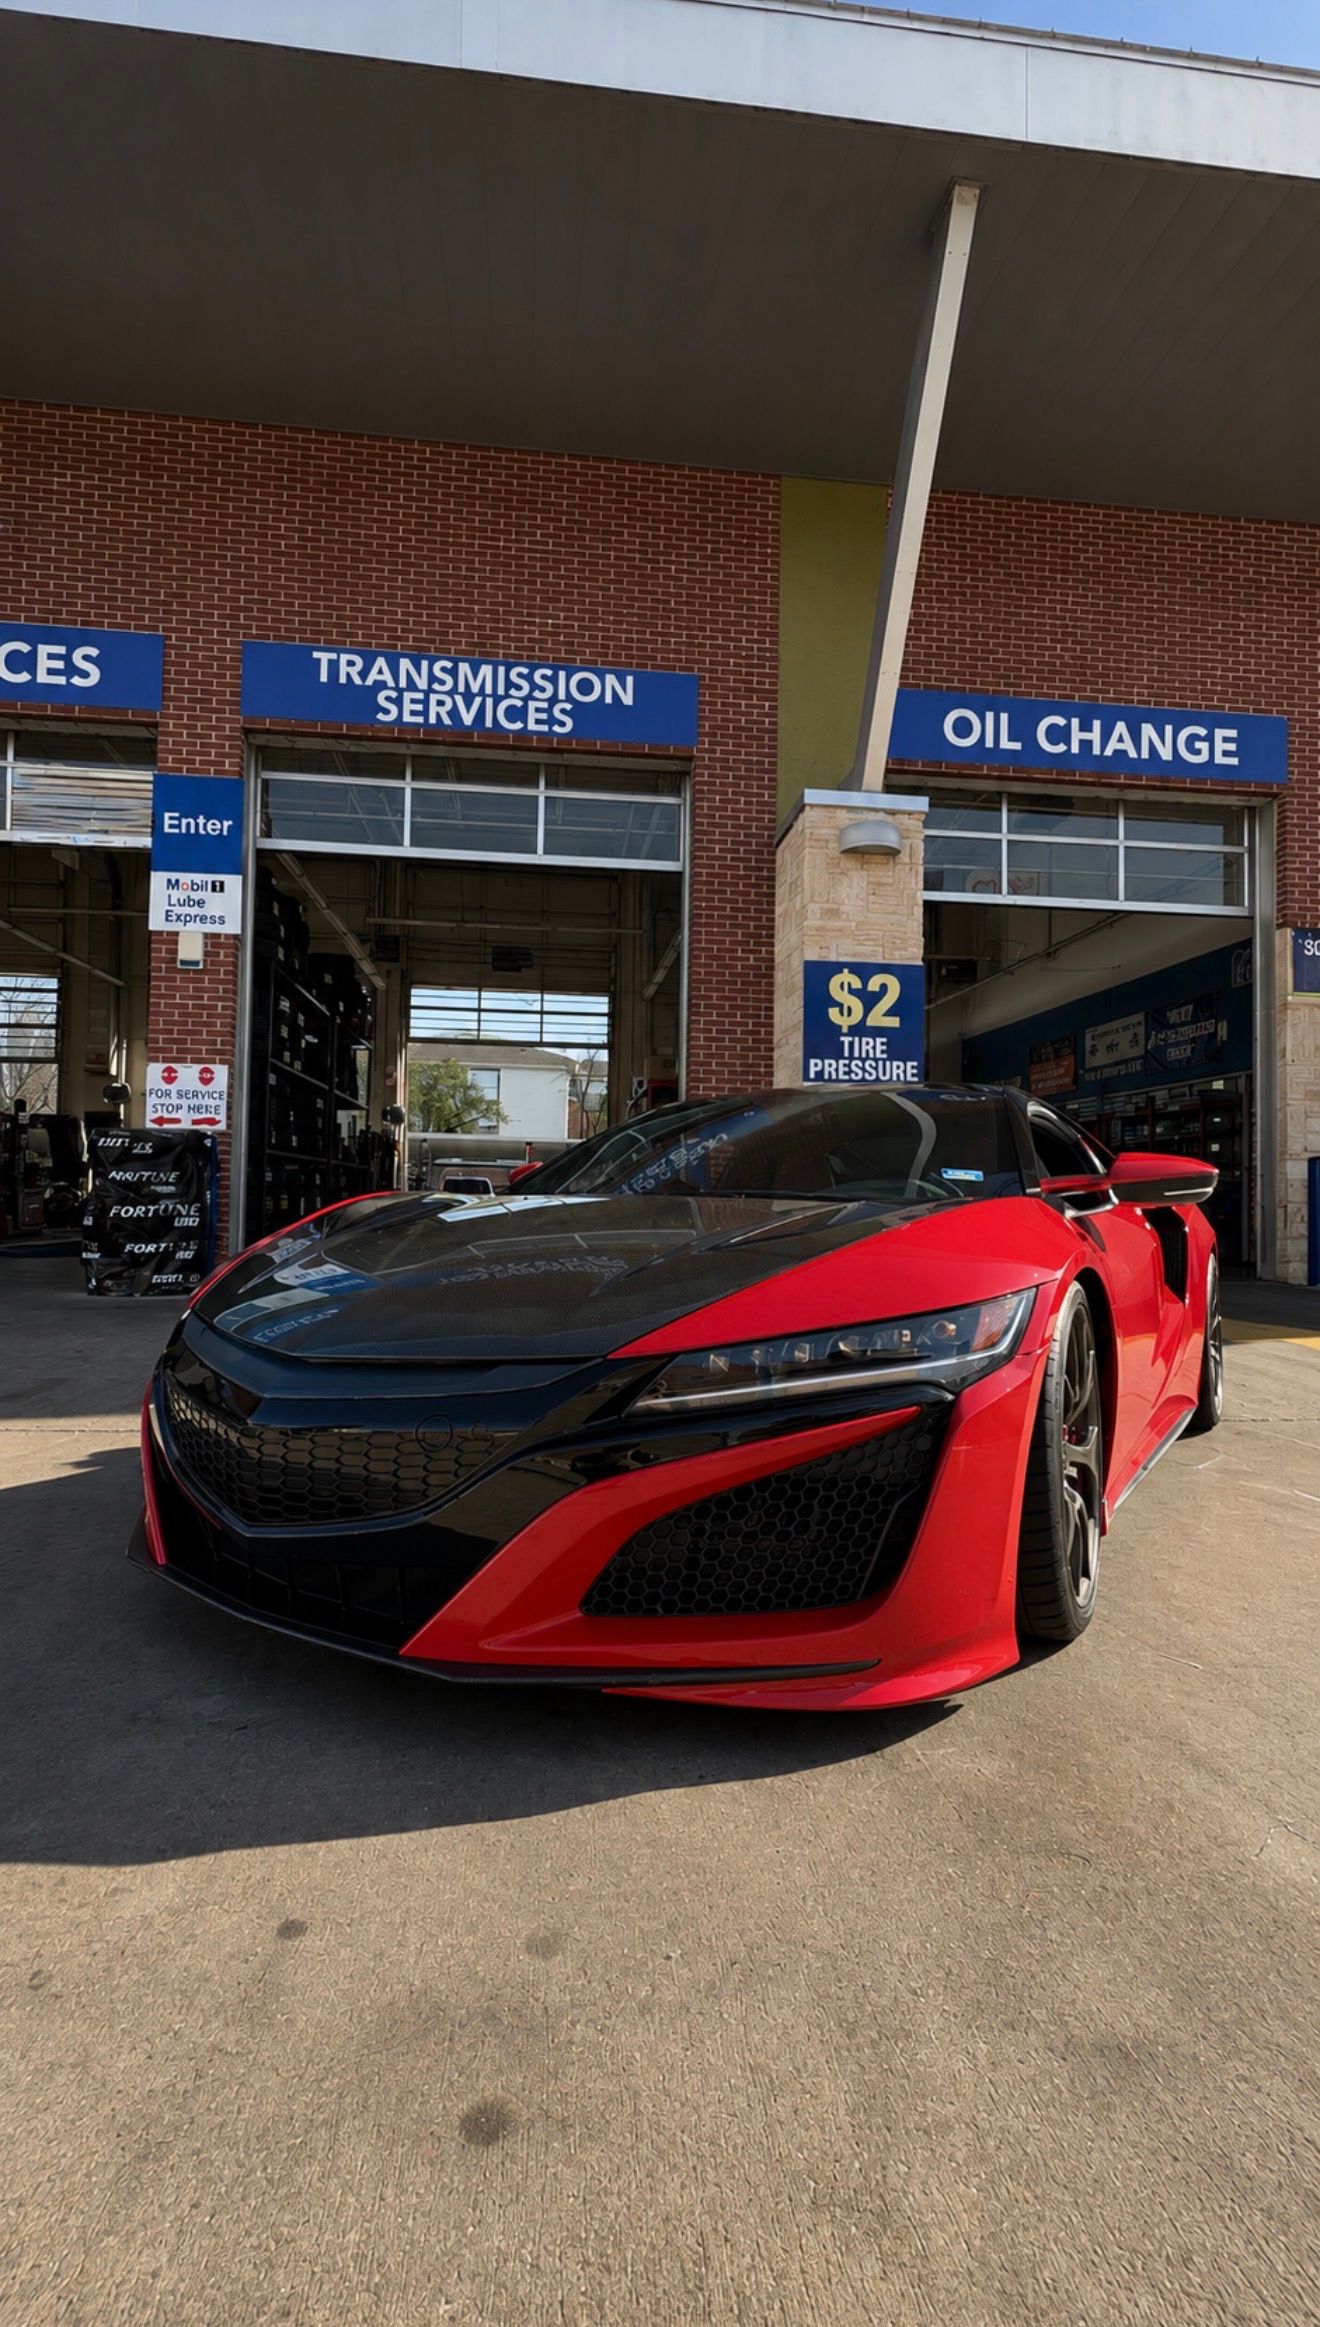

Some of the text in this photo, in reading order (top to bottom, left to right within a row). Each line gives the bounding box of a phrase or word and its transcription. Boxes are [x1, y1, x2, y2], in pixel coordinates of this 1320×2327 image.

[0, 641, 100, 687] CES
[312, 651, 634, 705] TRANSMISSION
[376, 690, 574, 733] SERVICES
[943, 708, 1239, 766] OIL CHANGE
[163, 812, 233, 836] Enter
[166, 878, 208, 892] Mobil
[168, 894, 206, 908] Lube
[165, 909, 226, 927] Express
[828, 968, 901, 1033] $2
[840, 1036, 888, 1058] TIRE
[809, 1059, 919, 1082] PRESSURE
[148, 1088, 225, 1101] FOR SERVICE
[151, 1103, 183, 1114] STOP
[109, 1203, 201, 1218] FORTUNE
